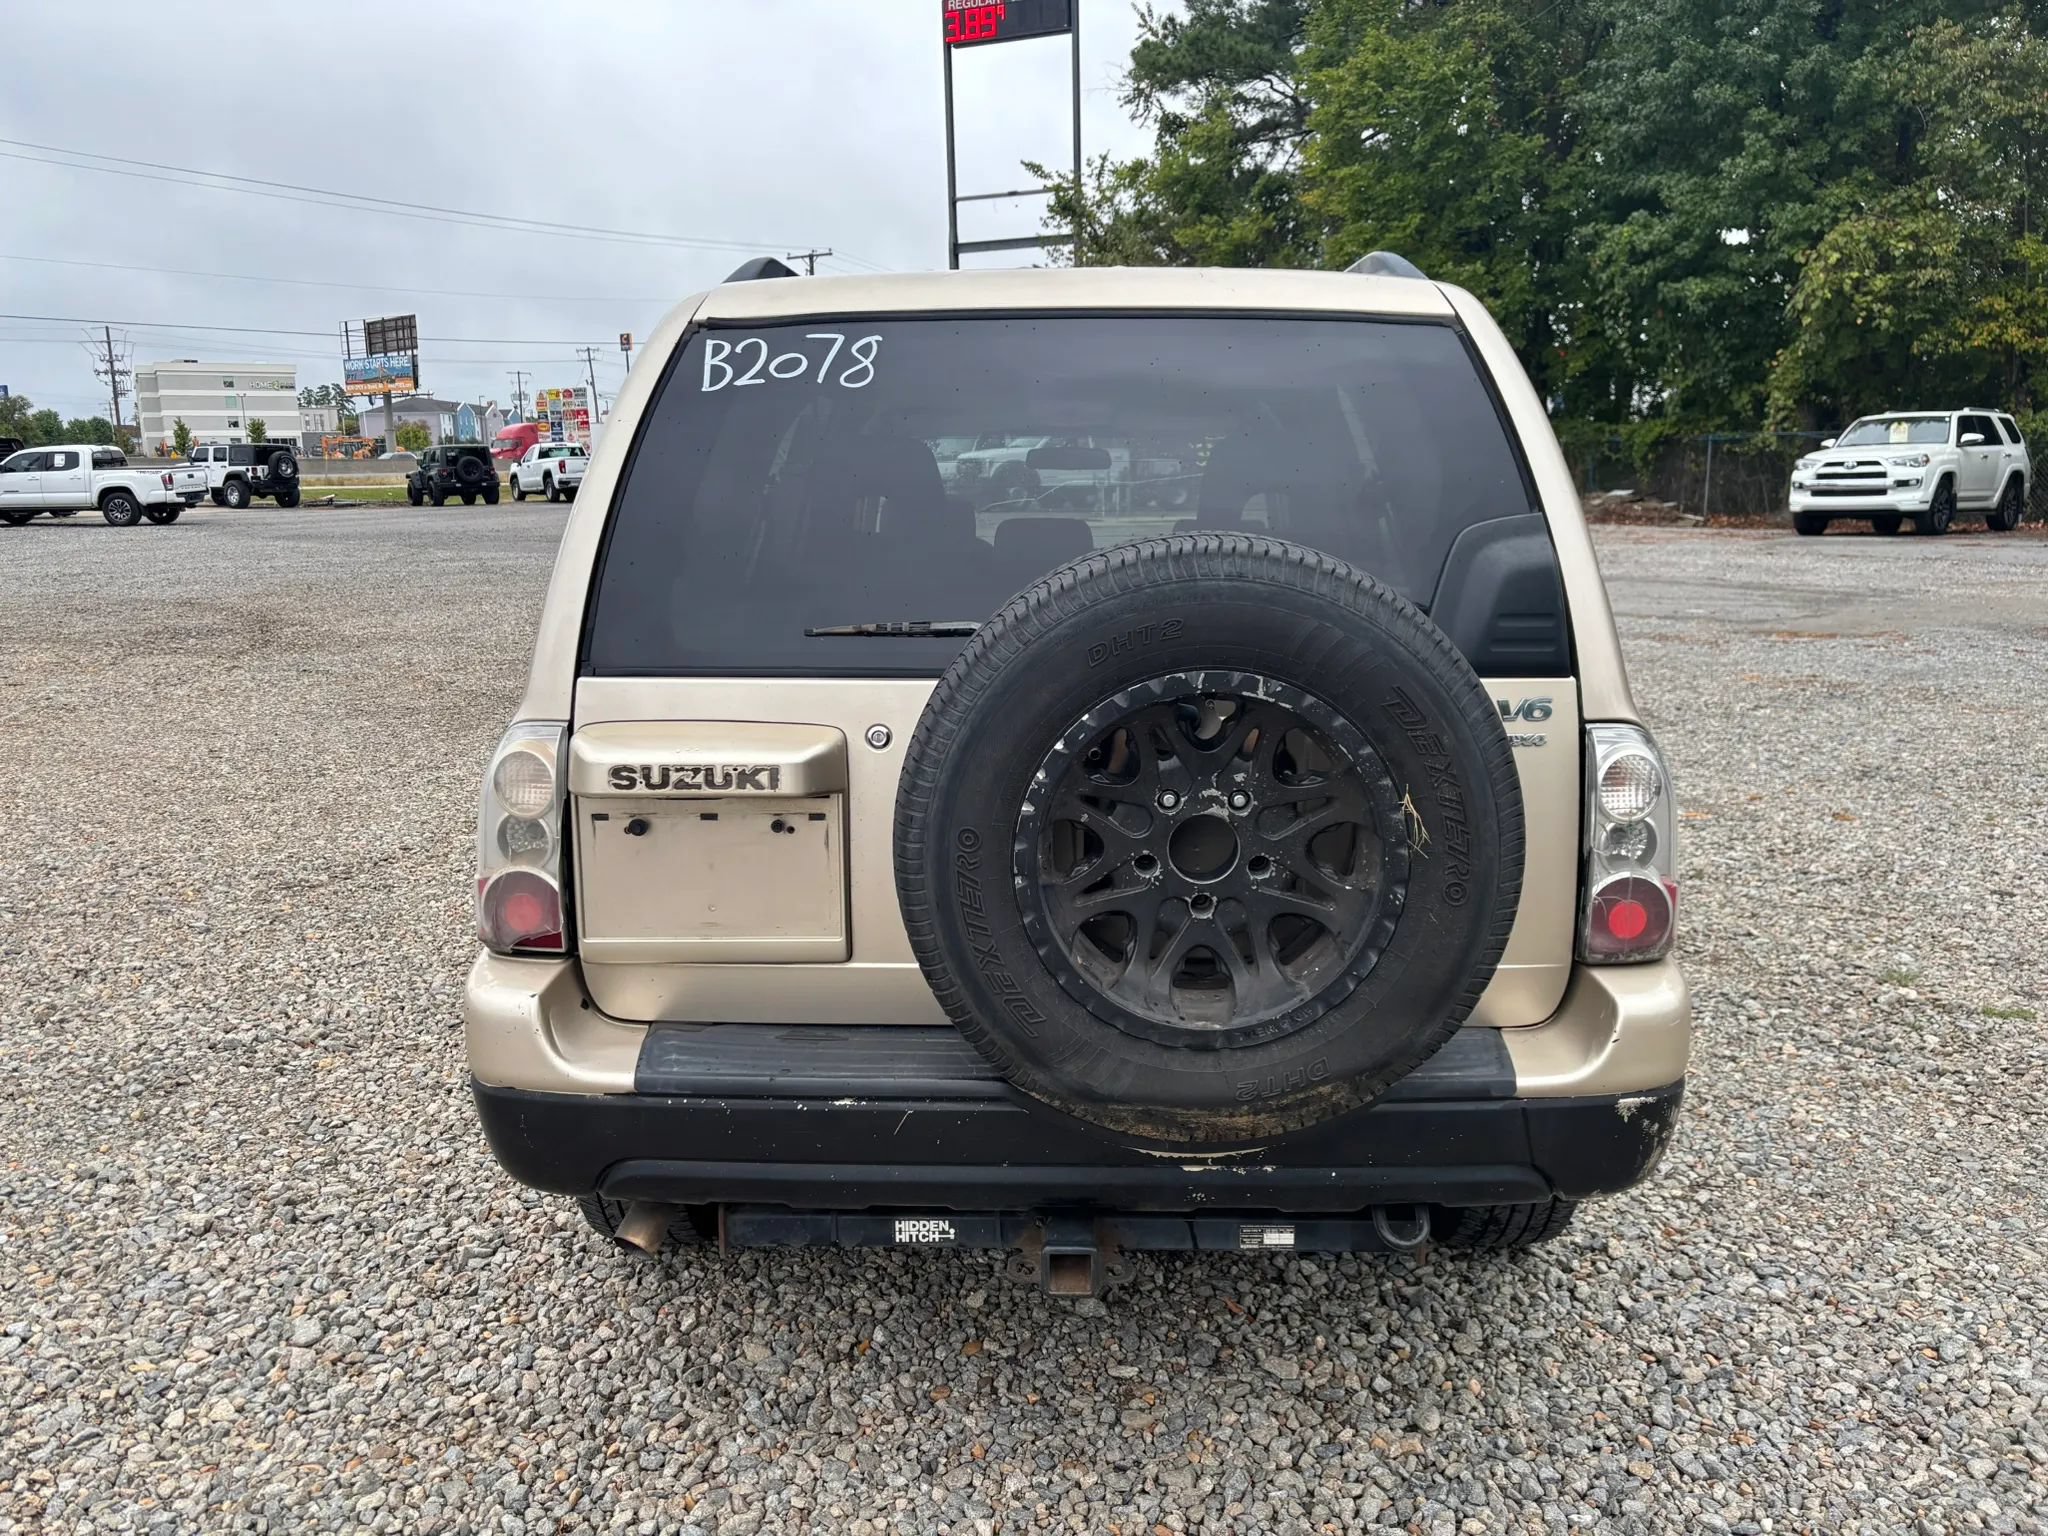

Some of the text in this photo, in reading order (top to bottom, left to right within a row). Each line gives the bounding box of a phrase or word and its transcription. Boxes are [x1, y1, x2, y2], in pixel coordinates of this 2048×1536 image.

[345, 359, 365, 371] WORK
[365, 357, 389, 370] STARTS
[701, 333, 884, 392] B2078
[1087, 618, 1186, 669] DHT2
[1497, 696, 1553, 722] V6
[608, 764, 780, 791] SUZUKI
[1382, 685, 1472, 907] DEXTERO
[955, 826, 1047, 1039] DEXTERO
[1235, 1056, 1331, 1101] DHT2
[895, 1220, 949, 1232] HIDDEN
[895, 1231, 939, 1243] HITCH
